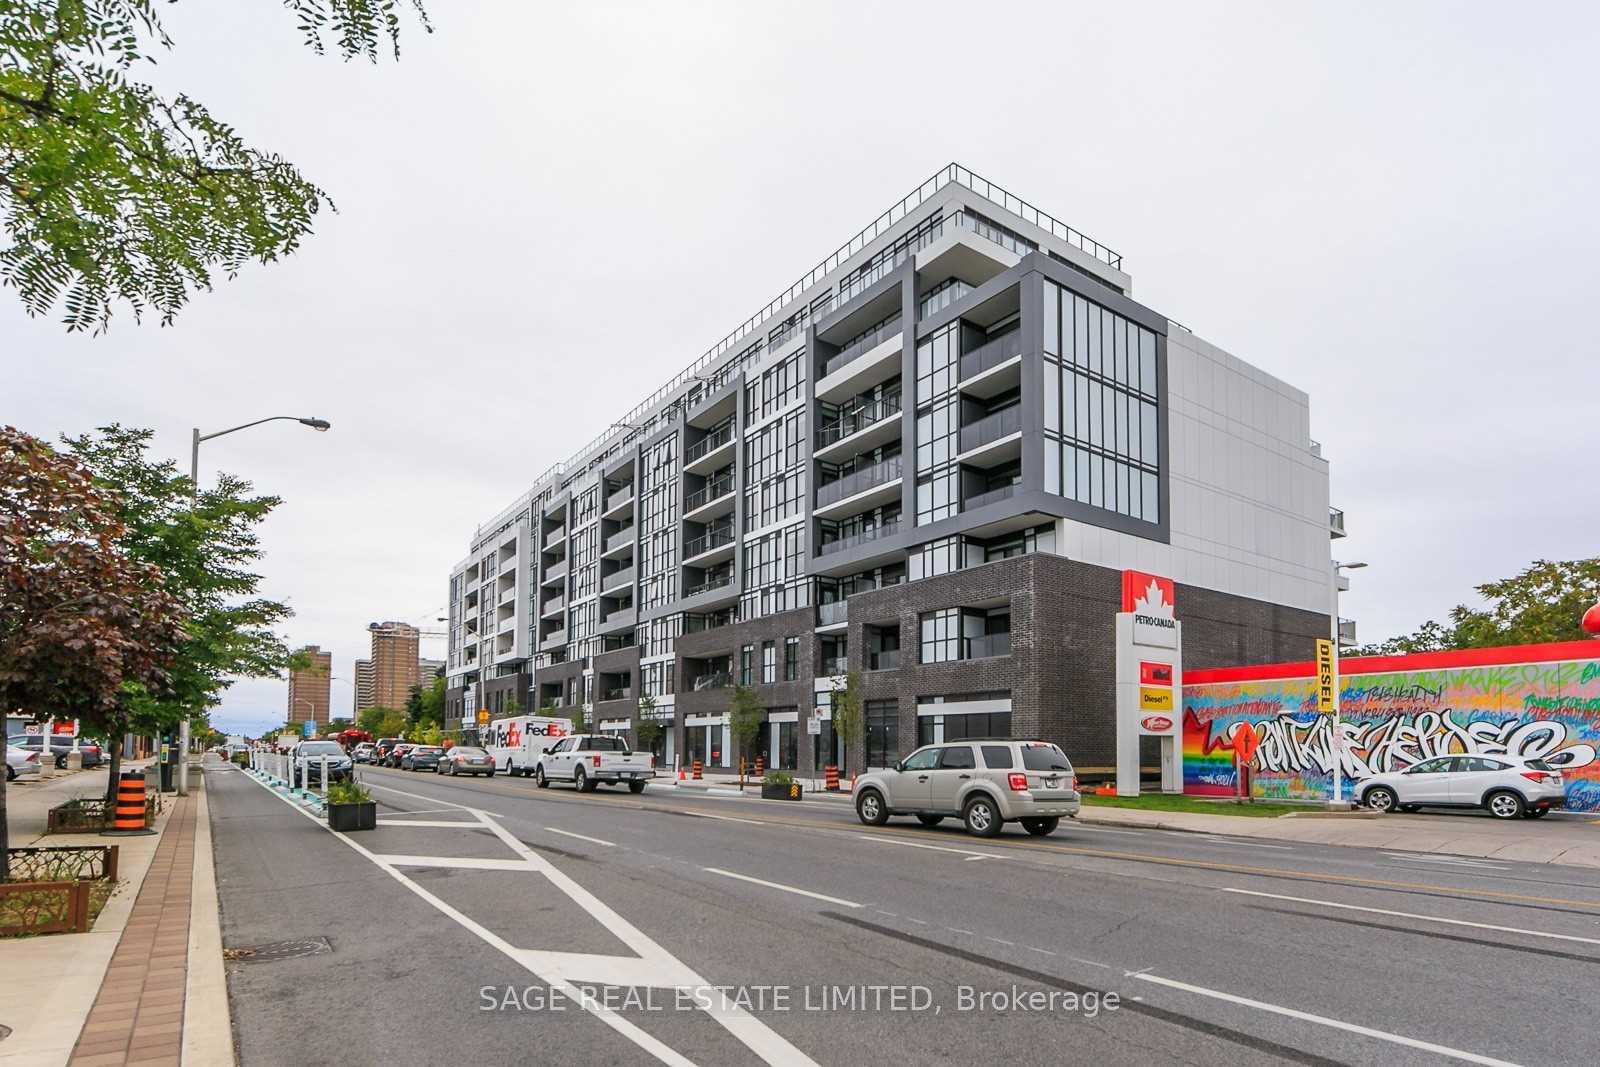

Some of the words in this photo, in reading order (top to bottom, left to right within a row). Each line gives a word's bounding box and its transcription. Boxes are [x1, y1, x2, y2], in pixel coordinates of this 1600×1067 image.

[1320, 644, 1331, 706] DIESEL
[1144, 694, 1163, 704] Diesel
[496, 721, 521, 748] FedEx
[525, 722, 568, 737] FedEx
